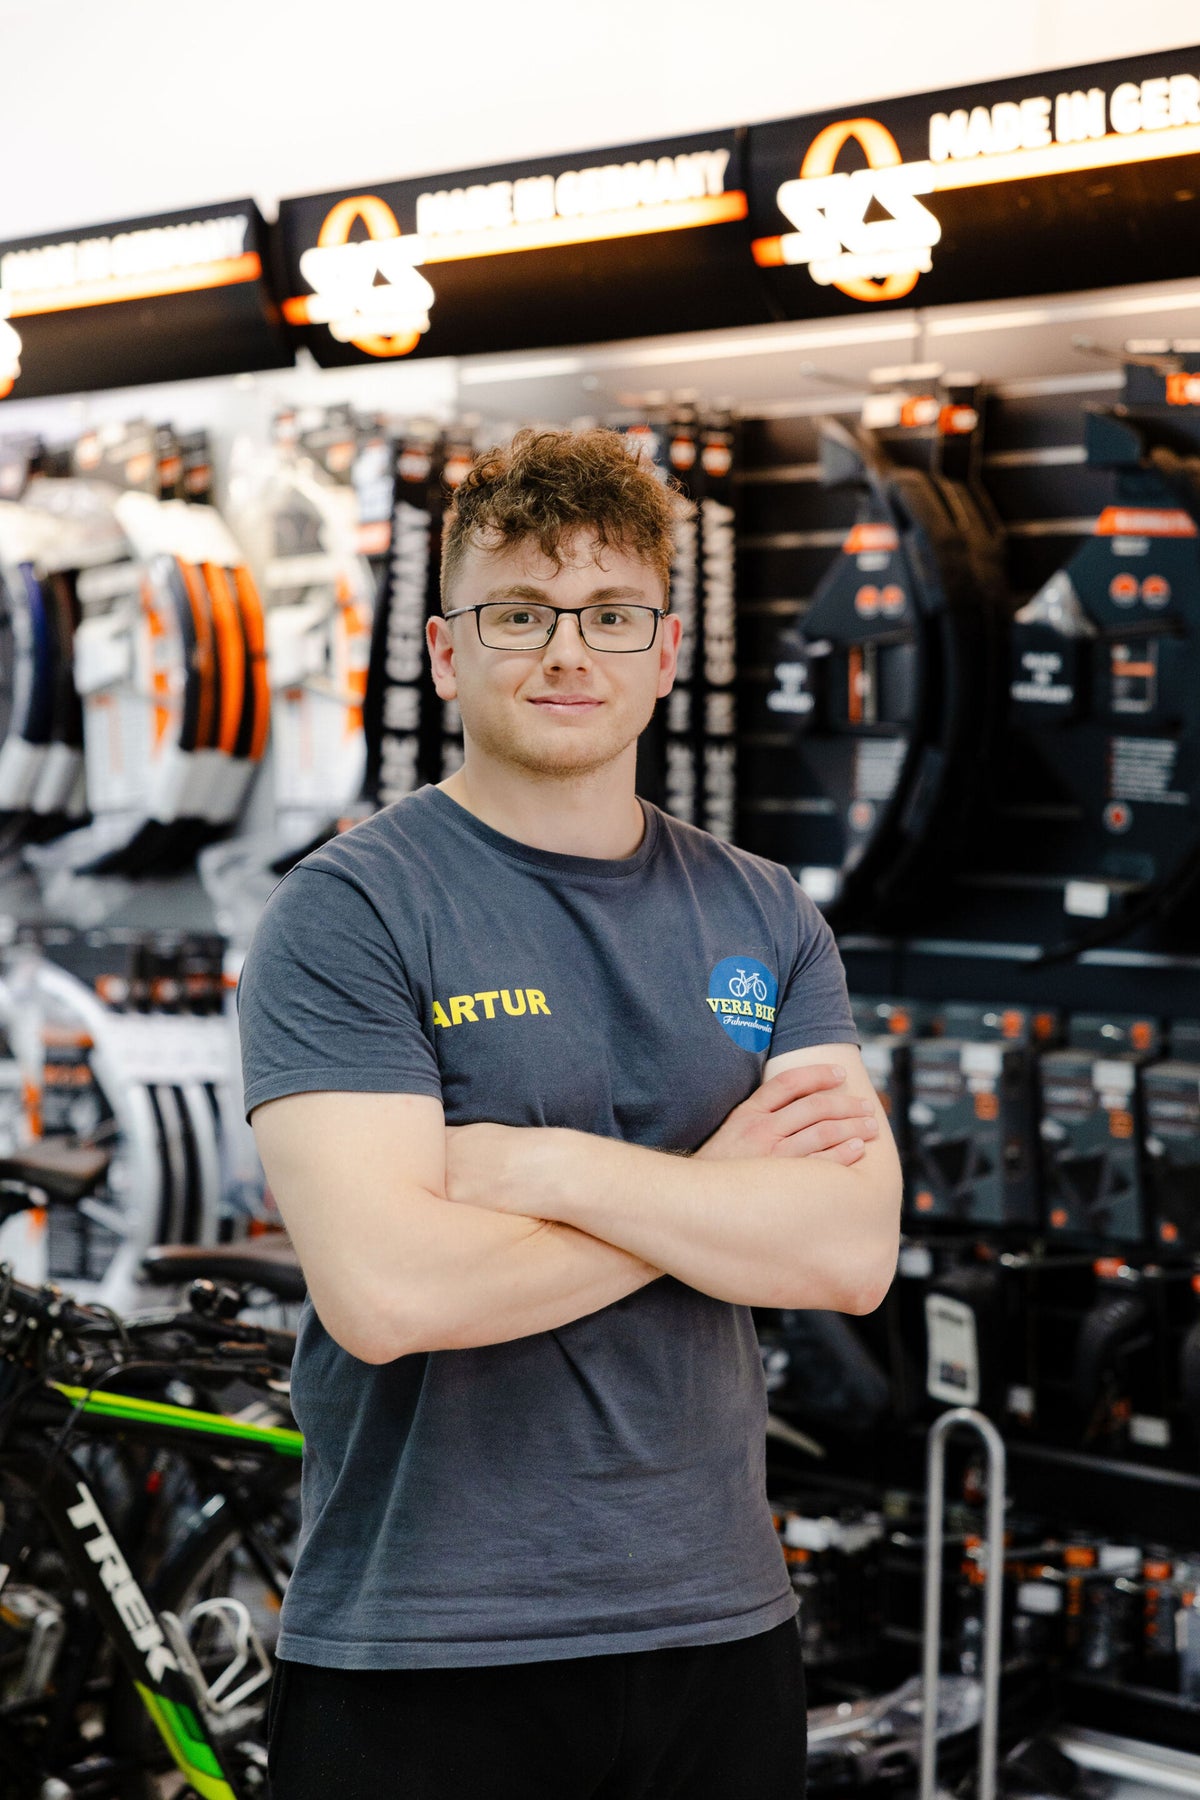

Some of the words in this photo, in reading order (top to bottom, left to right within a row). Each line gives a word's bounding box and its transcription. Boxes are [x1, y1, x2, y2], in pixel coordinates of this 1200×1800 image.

[929, 95, 1052, 162] MADE
[1055, 87, 1107, 143] IN
[1110, 74, 1200, 134] GER
[432, 988, 551, 1028] ARTUR
[706, 998, 753, 1016] VERA
[754, 1002, 777, 1022] BIK
[66, 1481, 180, 1684] TREK
